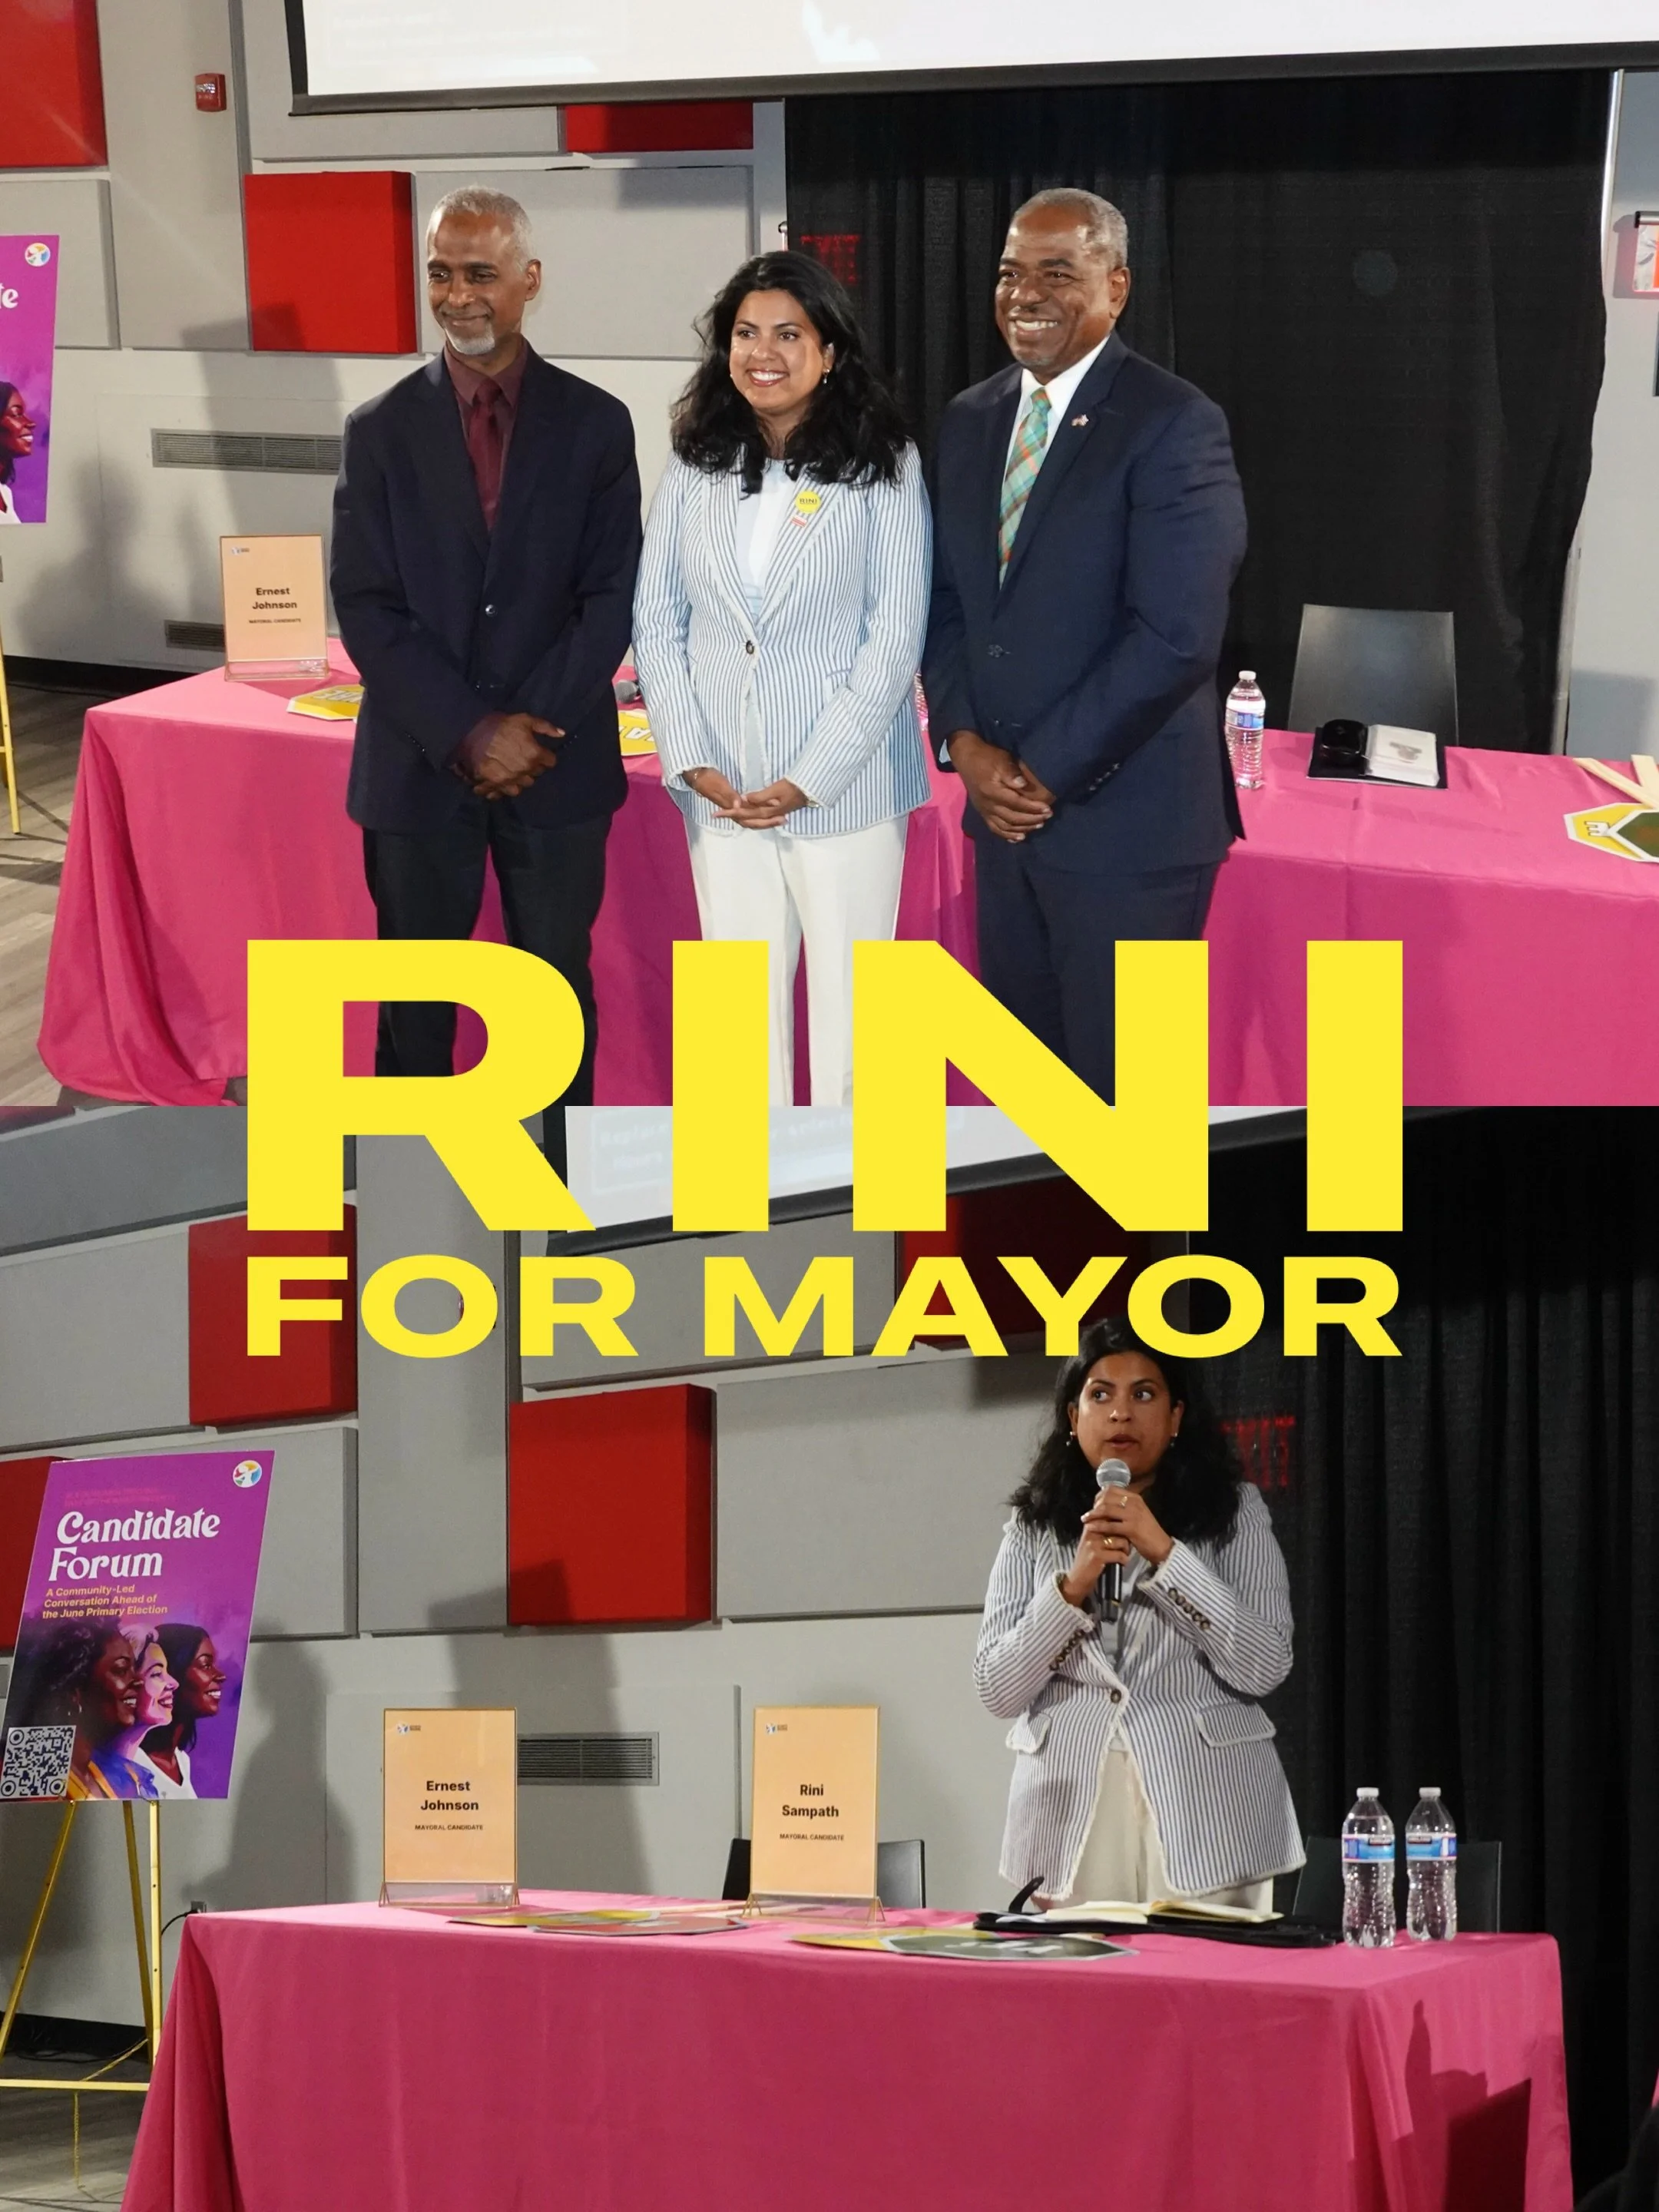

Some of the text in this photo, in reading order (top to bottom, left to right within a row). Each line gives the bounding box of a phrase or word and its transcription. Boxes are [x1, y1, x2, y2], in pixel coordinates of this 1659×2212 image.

[256, 587, 290, 596] Ernest
[57, 1508, 220, 1545] Candidate
[48, 1546, 163, 1581] Forum
[45, 1584, 135, 1597] A Community-Led
[44, 1594, 157, 1608] Conversation Ahead of
[42, 1604, 168, 1619] the June Primary Election
[426, 1780, 470, 1791] Ernest
[800, 1783, 824, 1796] Rini
[420, 1800, 479, 1811] Johnson
[782, 1804, 839, 1820] Sampath
